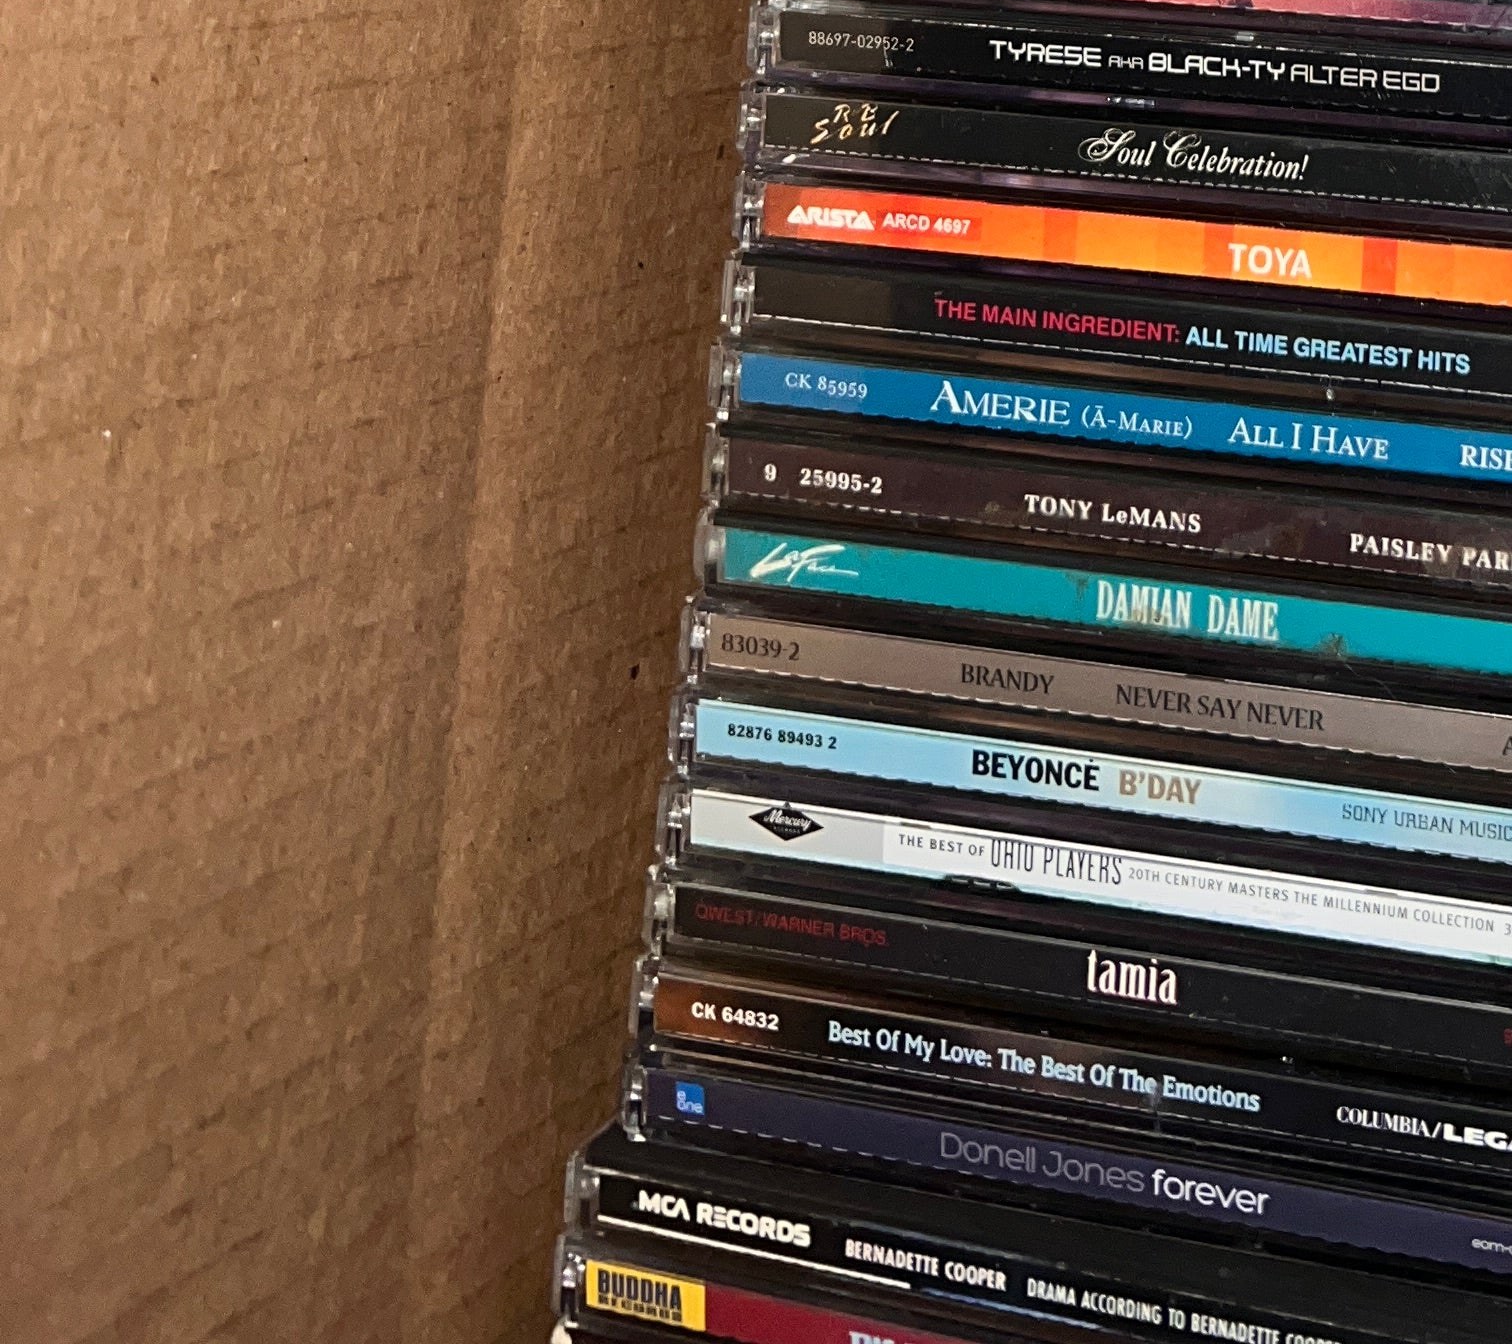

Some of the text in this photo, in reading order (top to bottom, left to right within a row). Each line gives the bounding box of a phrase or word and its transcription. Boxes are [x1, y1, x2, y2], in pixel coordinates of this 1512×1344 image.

[808, 30, 914, 52] 88697-02952-2
[989, 39, 1440, 93] TYRESE BLACK-TY ALTER EGO
[1228, 243, 1312, 279] TOYA
[934, 298, 1471, 375] THE MAIN INGREDIENT: ALL TIME GREATEST HITS
[800, 468, 882, 494] 25995-2
[1024, 494, 1201, 533] TONY LeMANS
[1096, 580, 1280, 641] DAMIAN DAME
[961, 663, 1325, 732] BRANDY NEVER SAY NEVER
[1119, 770, 1201, 805] B'DAY
[1165, 872, 1495, 933] CENTURY MASTERS THE MILLENNIUM COLLECTION
[1086, 948, 1177, 1005] tamia
[691, 1002, 779, 1031] CK 64832
[828, 1020, 1261, 1112] Best Of My Love: The Best Of The Emotions
[941, 1132, 1271, 1215] Donell Jones forever
[638, 1190, 811, 1249] MCA RECORDS
[846, 1239, 1007, 1292] BERNADETTE COOPER
